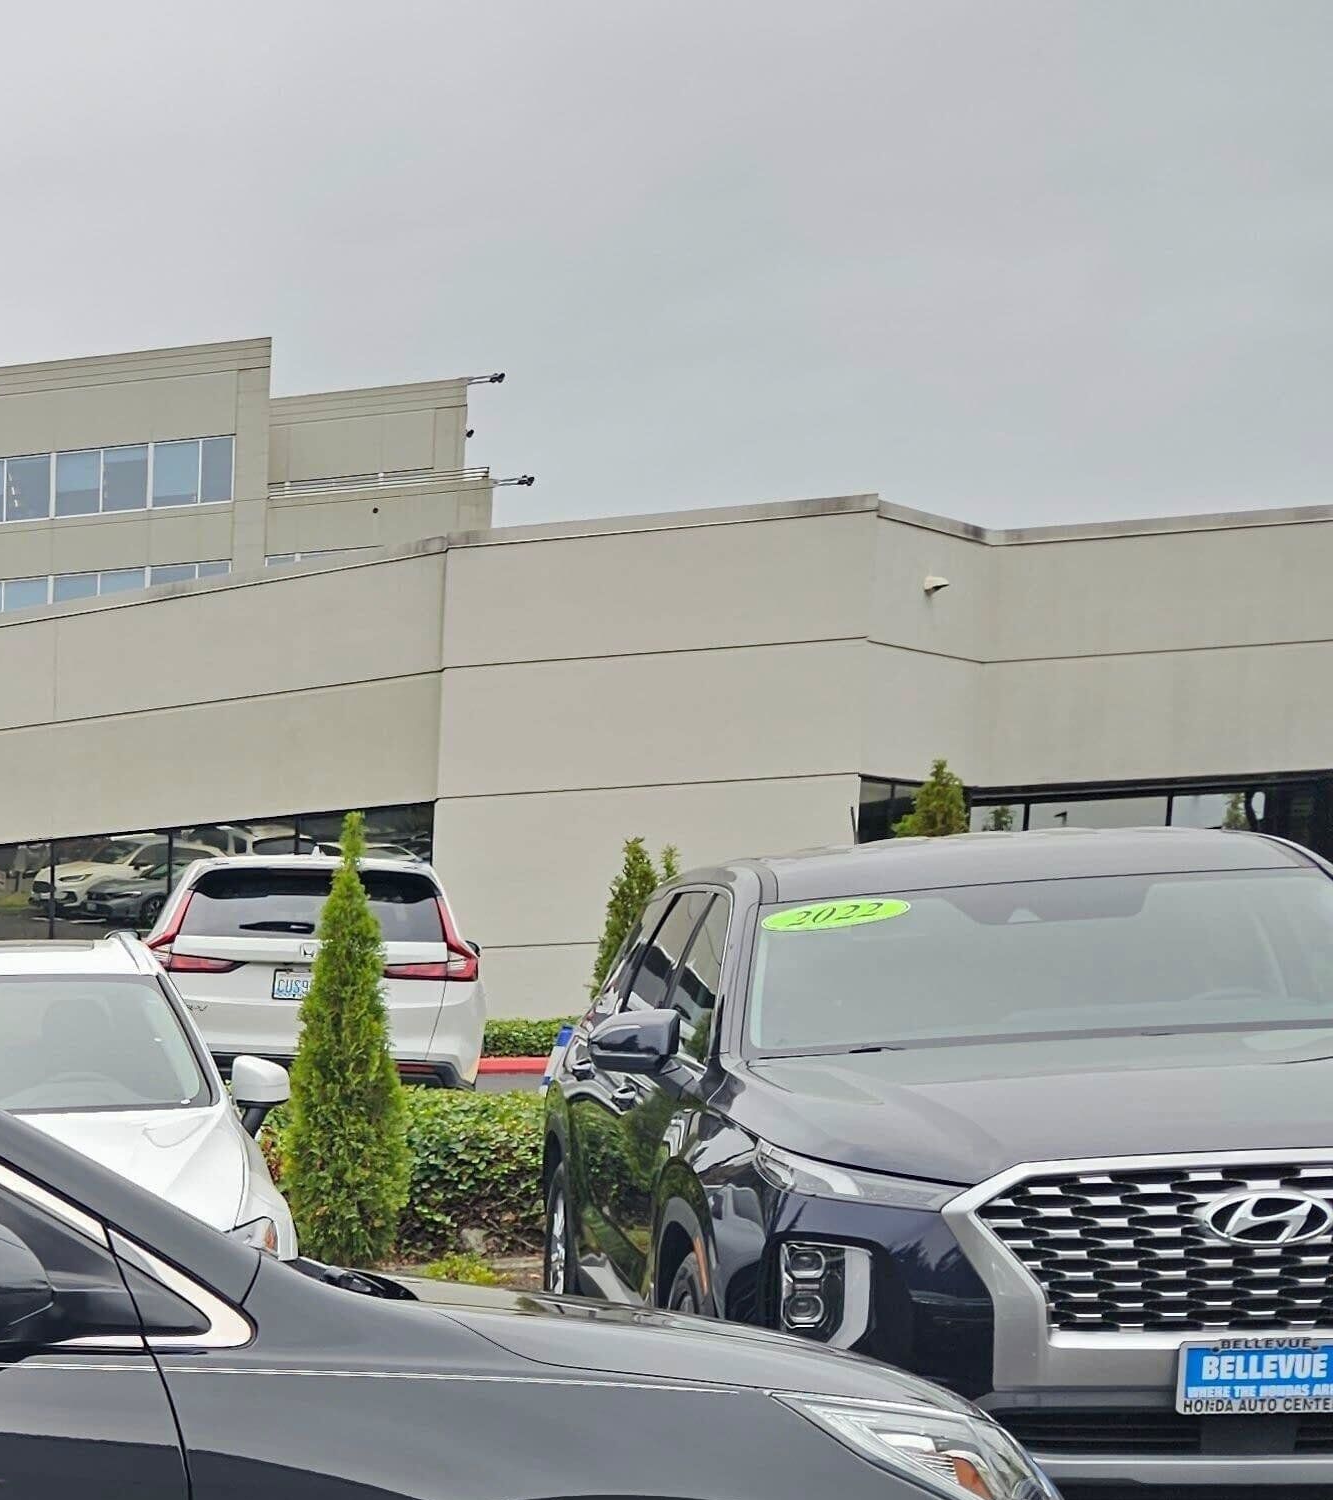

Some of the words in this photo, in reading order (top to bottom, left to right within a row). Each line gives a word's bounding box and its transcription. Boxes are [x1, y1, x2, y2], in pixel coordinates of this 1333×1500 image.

[786, 902, 884, 927] 2022
[1221, 1338, 1311, 1350] BELLEVUE
[1201, 1353, 1329, 1381] BELLEVUE
[1183, 1399, 1233, 1413] HONDA
[1238, 1399, 1277, 1412] AUTO
[1283, 1398, 1333, 1411] CENTE
